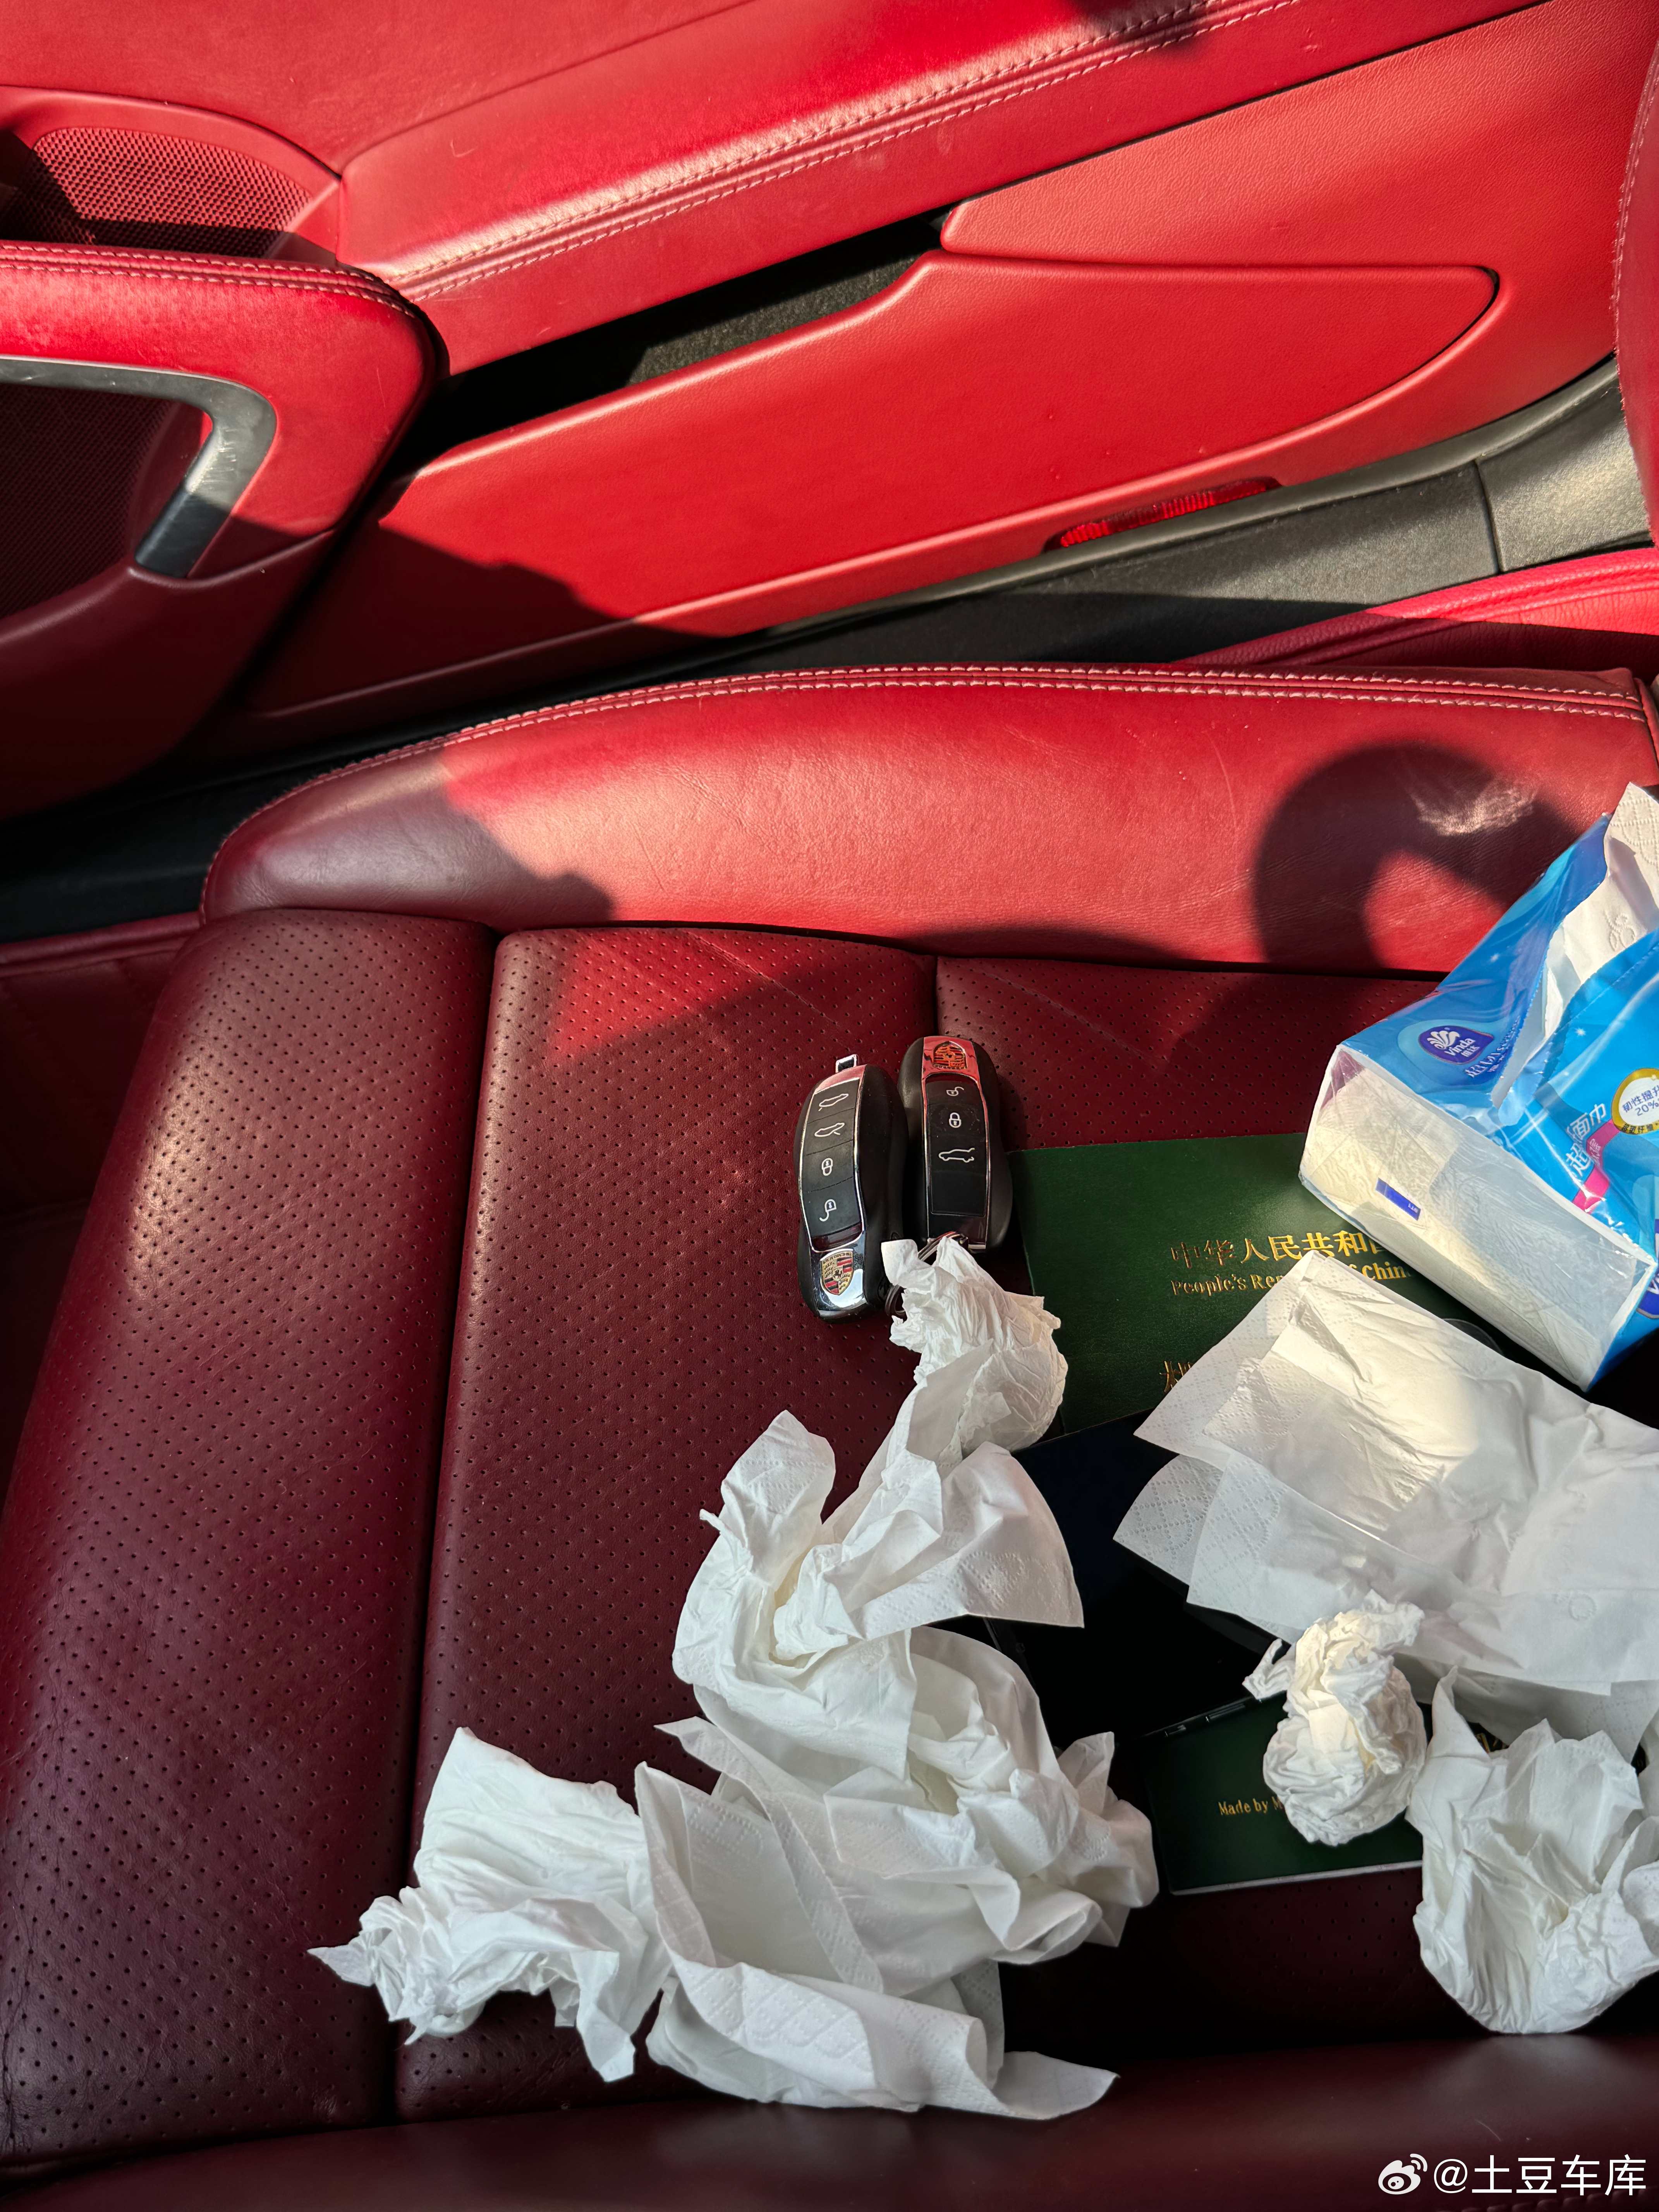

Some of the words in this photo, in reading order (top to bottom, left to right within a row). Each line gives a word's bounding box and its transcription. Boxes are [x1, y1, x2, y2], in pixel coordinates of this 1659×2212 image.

[1171, 1274, 1247, 1297] People's
[1362, 1262, 1411, 1280] Chin
[1218, 1800, 1251, 1815] Made
[1253, 1798, 1268, 1814] by
